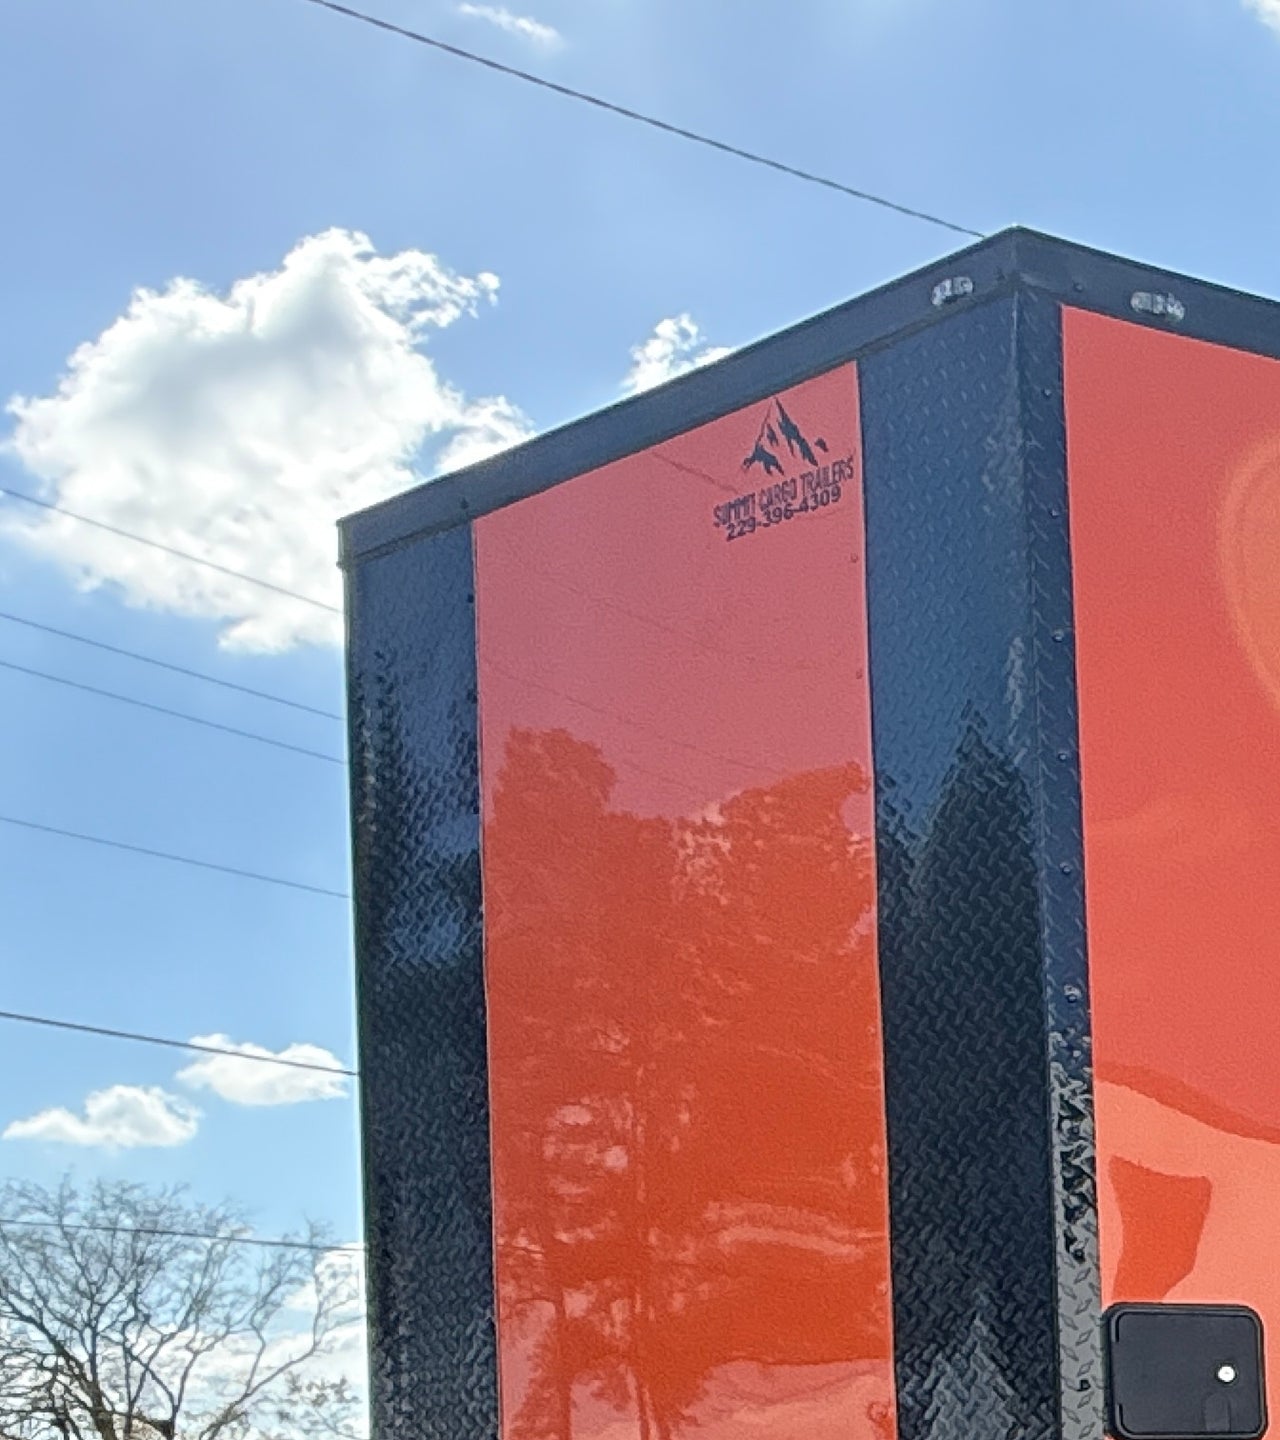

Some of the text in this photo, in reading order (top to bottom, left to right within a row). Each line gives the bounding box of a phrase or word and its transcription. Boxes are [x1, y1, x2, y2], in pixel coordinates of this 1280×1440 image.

[713, 455, 854, 528] SUMMIT CARGO TRAILERS
